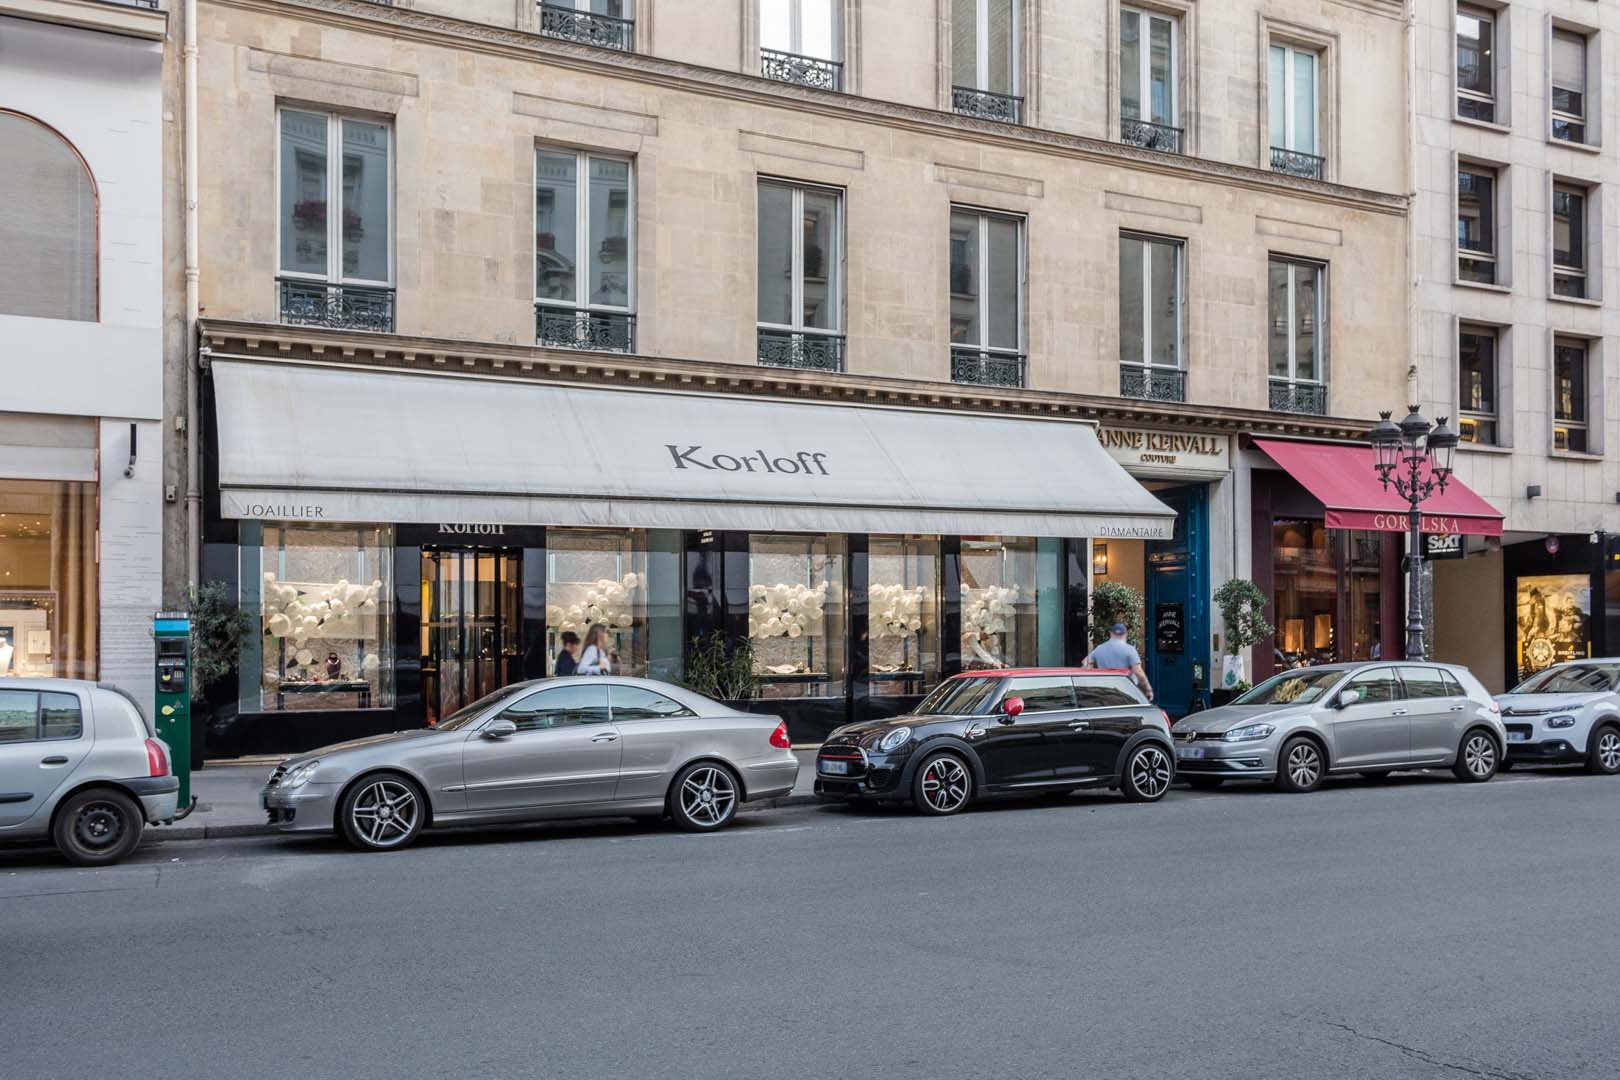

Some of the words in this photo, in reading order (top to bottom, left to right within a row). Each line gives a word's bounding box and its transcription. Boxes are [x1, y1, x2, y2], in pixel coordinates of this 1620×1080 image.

[1097, 428, 1143, 449] ANNE
[1145, 432, 1222, 456] KERVALL
[664, 444, 831, 476] Korloff
[1140, 453, 1177, 464] COUTURE
[242, 504, 325, 518] JOAILLIER
[1100, 526, 1164, 537] DIAMANTAIRE
[1374, 514, 1460, 533] GORLSKA
